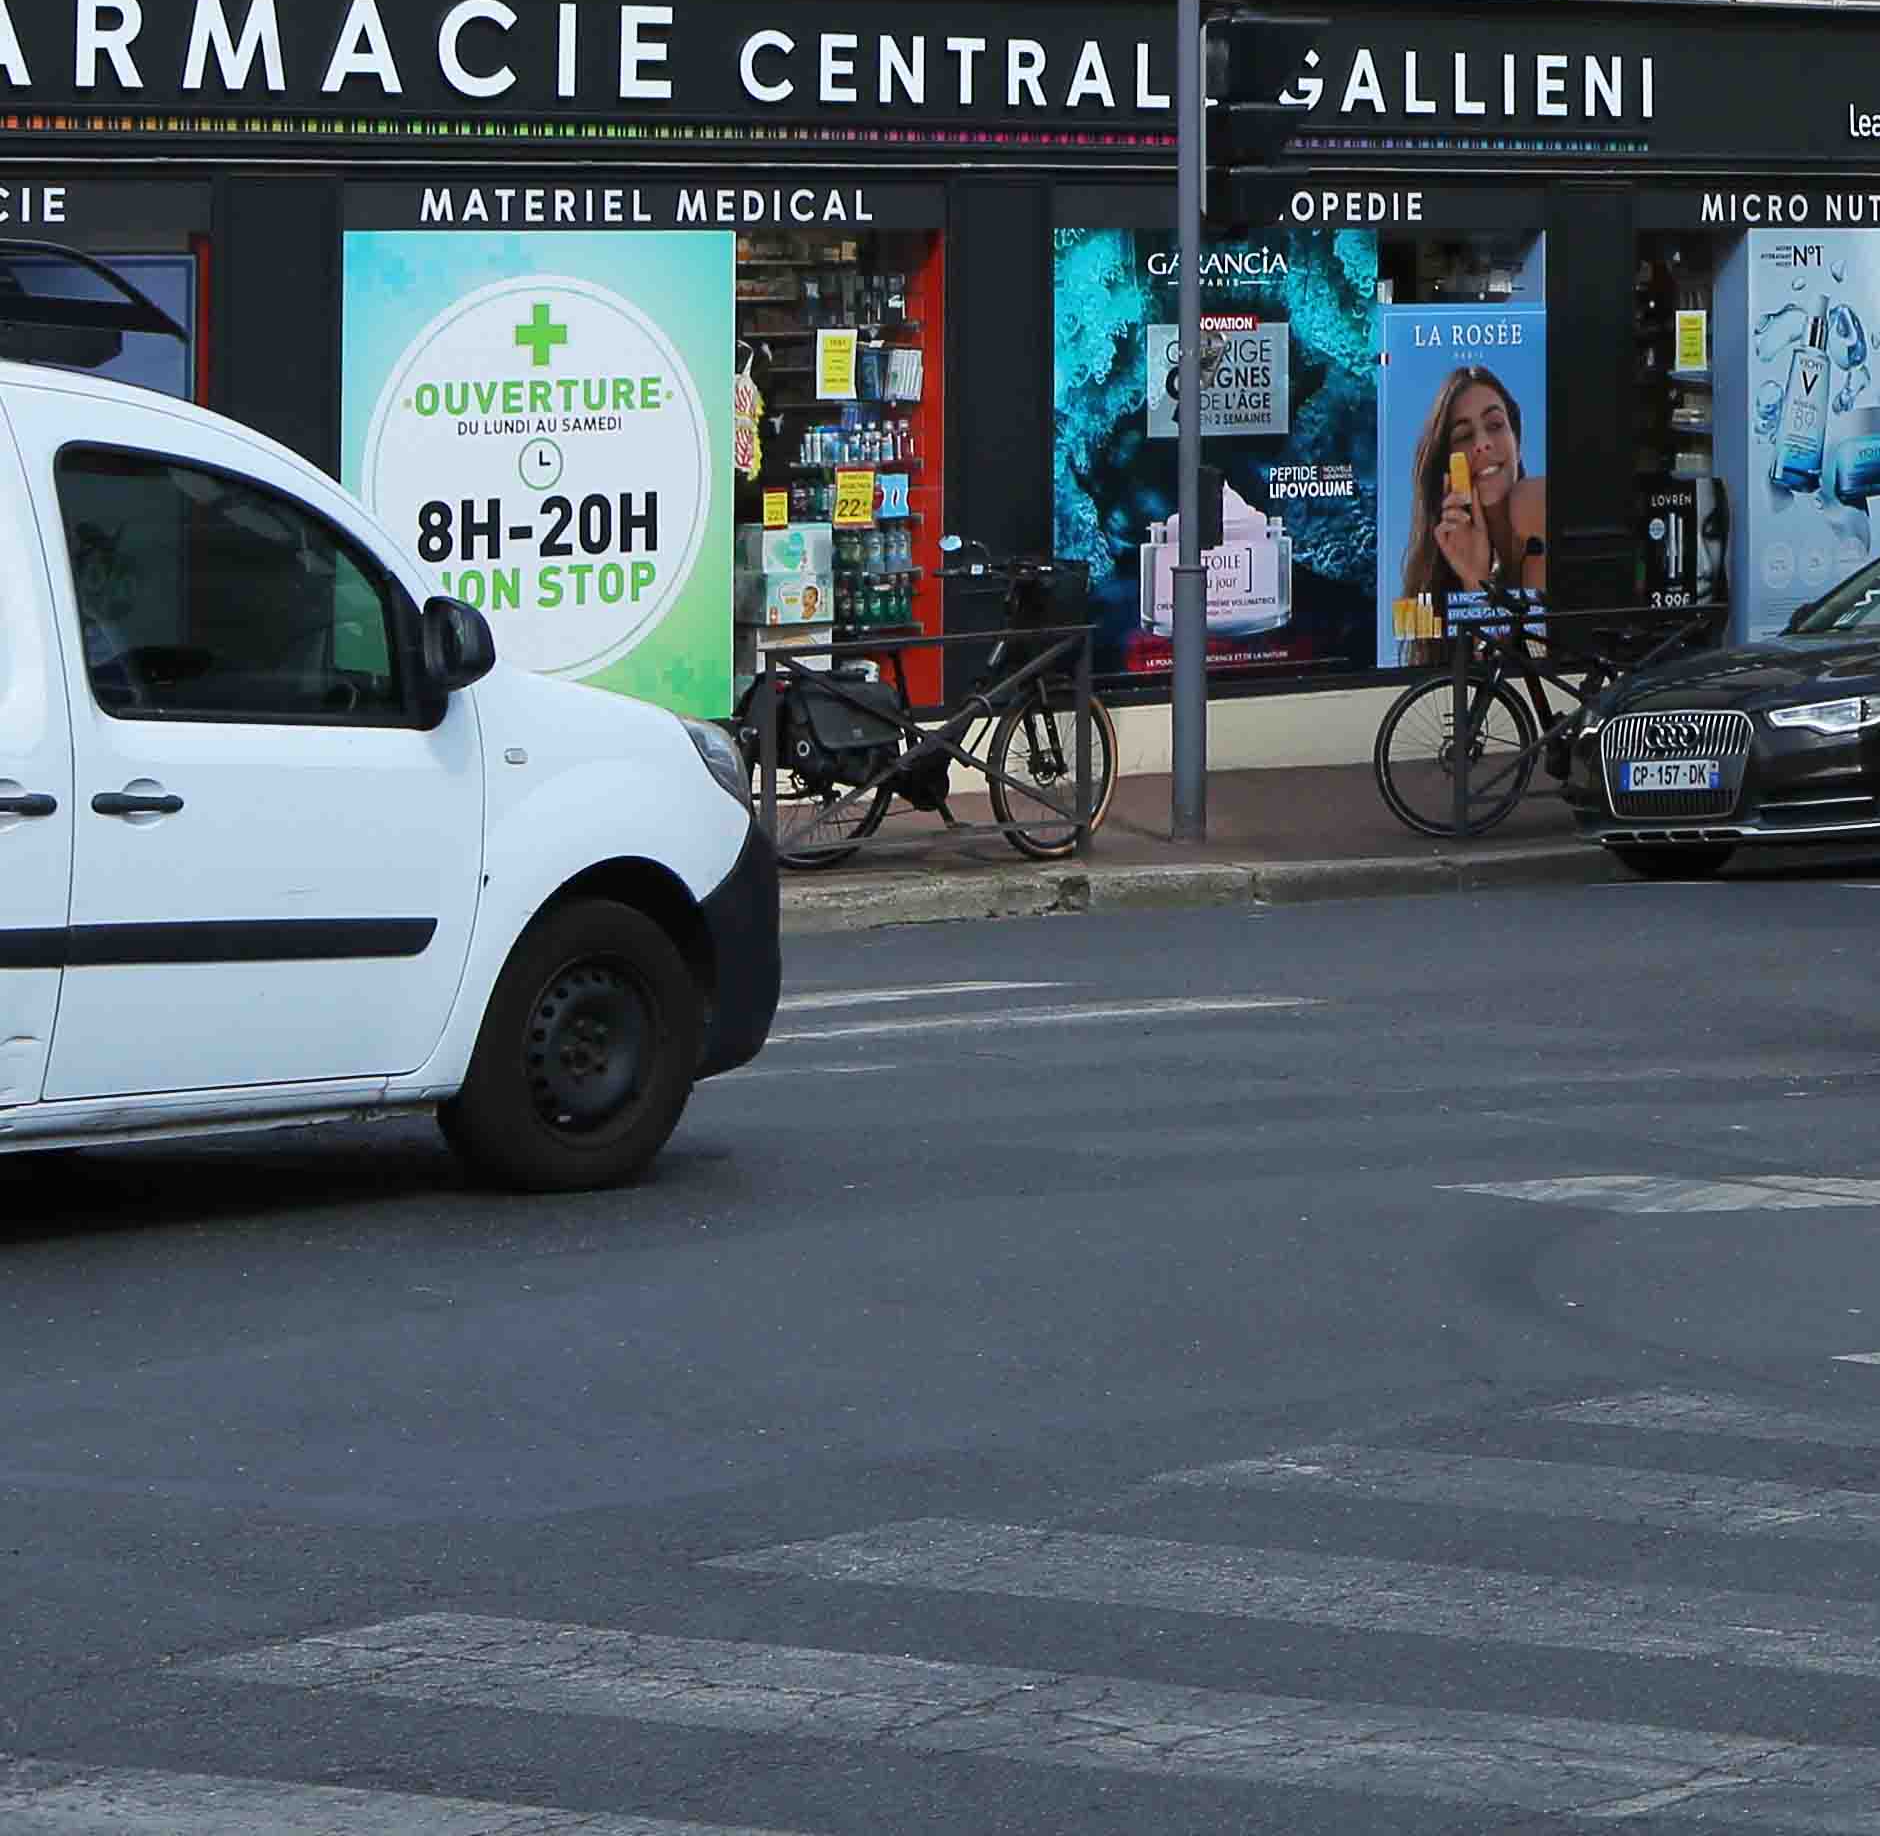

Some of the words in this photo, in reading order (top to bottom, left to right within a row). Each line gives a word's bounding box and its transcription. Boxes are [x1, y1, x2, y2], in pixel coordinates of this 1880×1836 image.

[740, 30, 1219, 109] CENTRAL
[420, 187, 653, 224] MATERIEL
[676, 188, 875, 224] MEDICAL
[1279, 191, 1424, 221] OPEDIE
[1701, 195, 1810, 224] MICRO
[1415, 324, 1442, 346] LA
[1452, 317, 1523, 346] ROSÉE
[415, 377, 662, 417] OUVERTURE
[457, 420, 479, 436] DU
[484, 419, 530, 435] LUNDI
[536, 418, 557, 433] AU
[562, 416, 623, 432] SAMEDI
[1269, 465, 1318, 482] PEPTIDE
[1269, 480, 1354, 499] LIPOVOLUME
[418, 491, 658, 563] 8H-20H
[1201, 554, 1241, 569] TOILE
[537, 561, 656, 609] STOP
